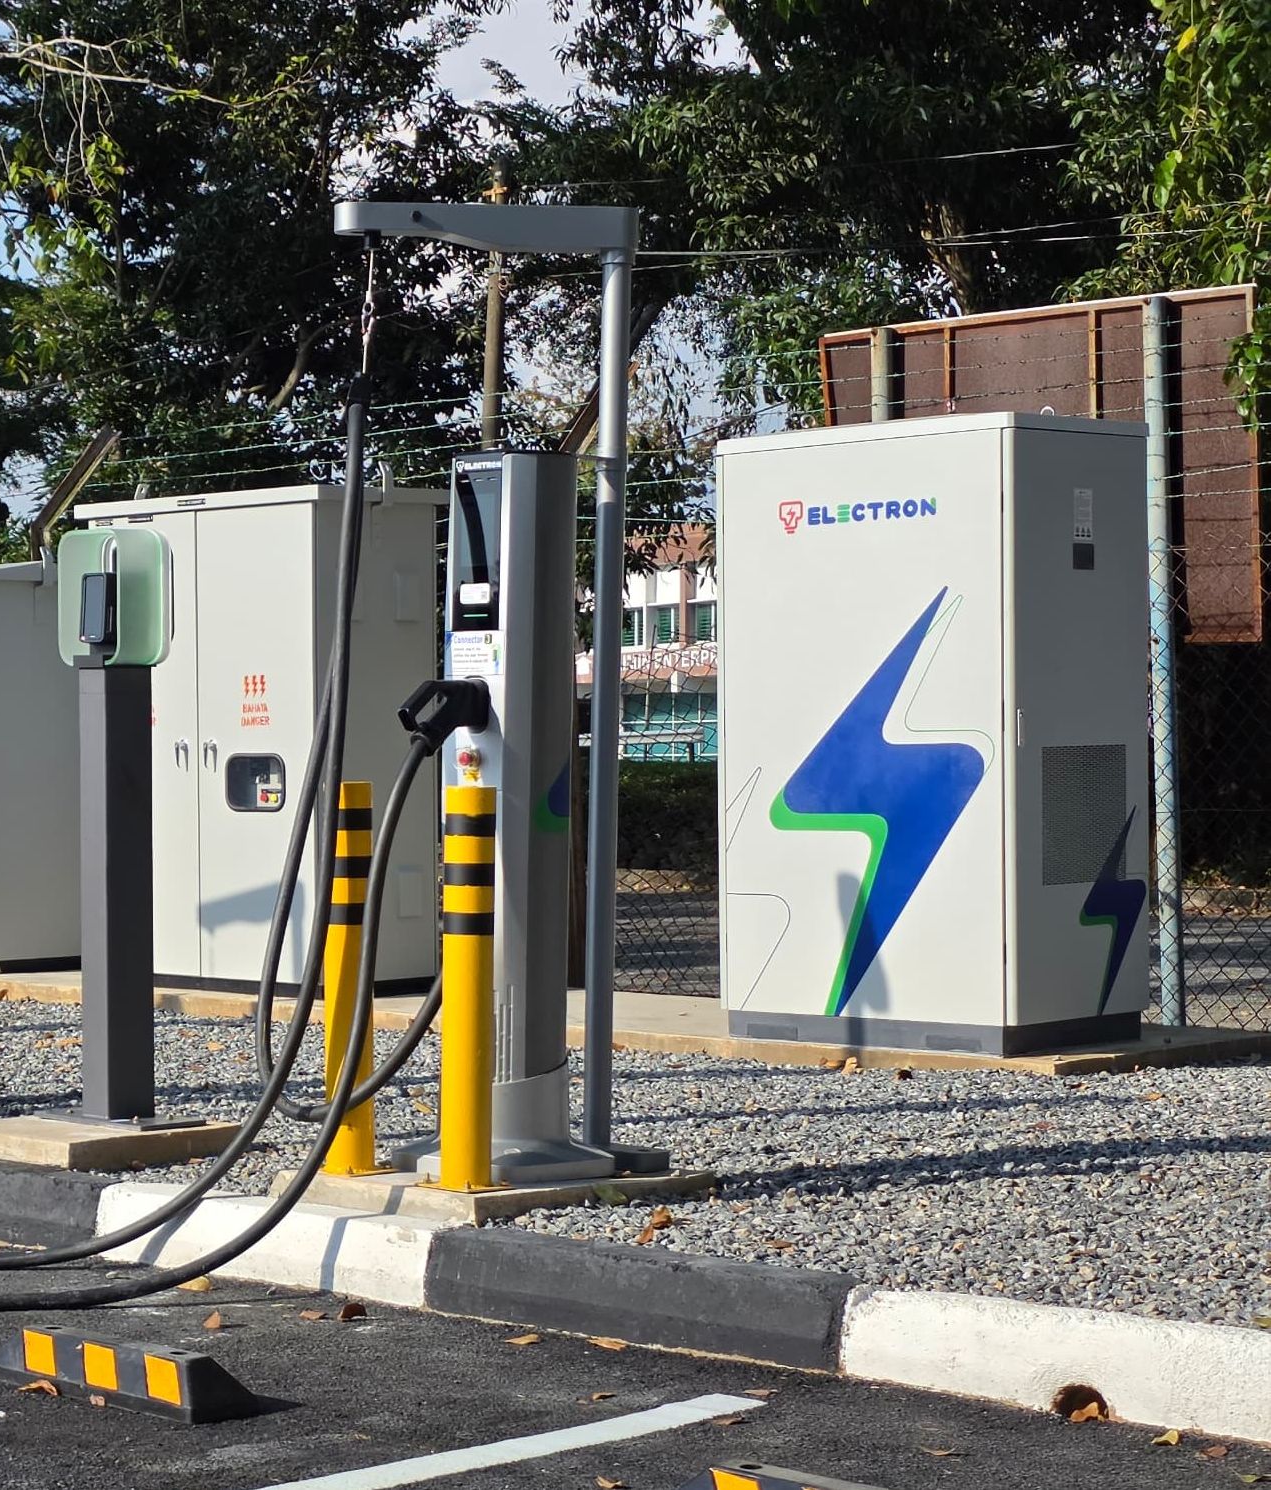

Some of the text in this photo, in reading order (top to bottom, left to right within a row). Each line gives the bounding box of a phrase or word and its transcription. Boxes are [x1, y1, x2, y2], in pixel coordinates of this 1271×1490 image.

[807, 497, 937, 526] ELECTRON
[242, 703, 268, 713] BAHAYA
[241, 716, 270, 727] DANGER
